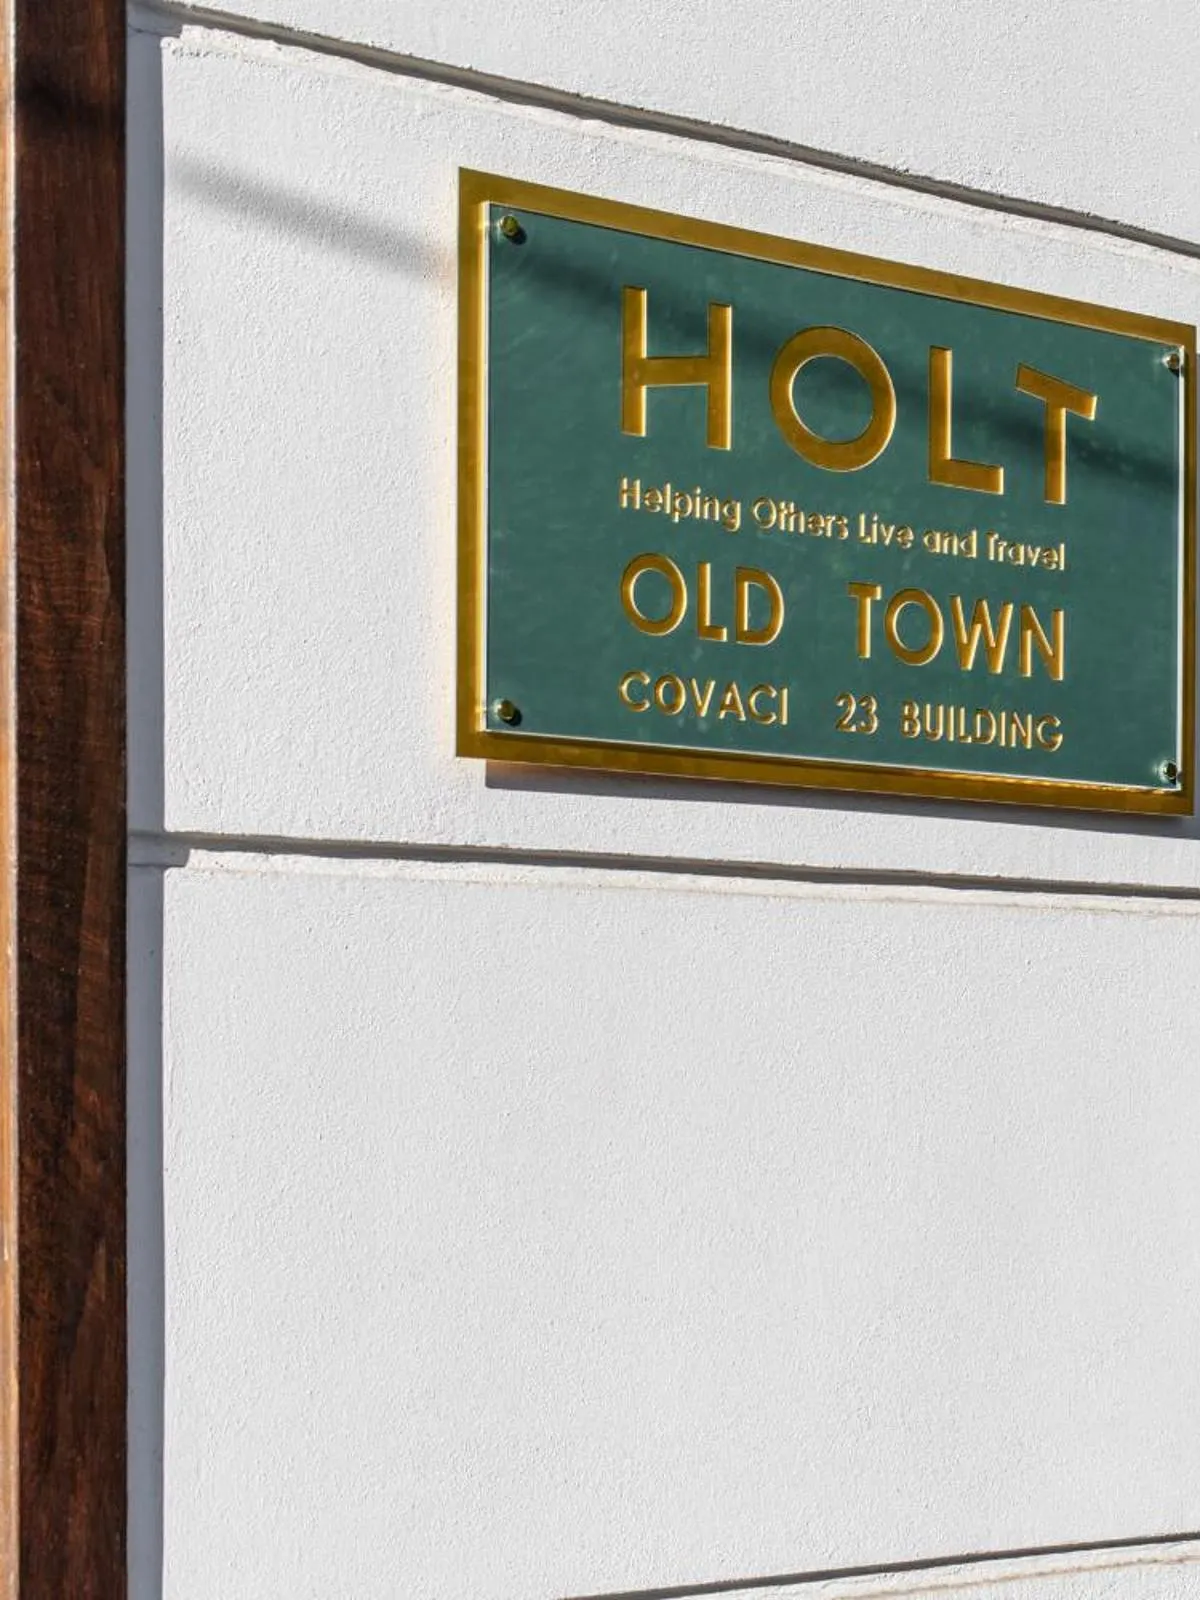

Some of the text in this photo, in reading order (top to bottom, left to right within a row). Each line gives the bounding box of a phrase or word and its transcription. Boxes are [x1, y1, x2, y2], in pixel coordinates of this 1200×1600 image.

[621, 286, 1098, 505] HOLT
[619, 476, 1065, 571] Helping Others Live and Travel
[620, 552, 1065, 681] OLD TOWN
[618, 670, 1064, 752] COVACI 23 BUILDING
